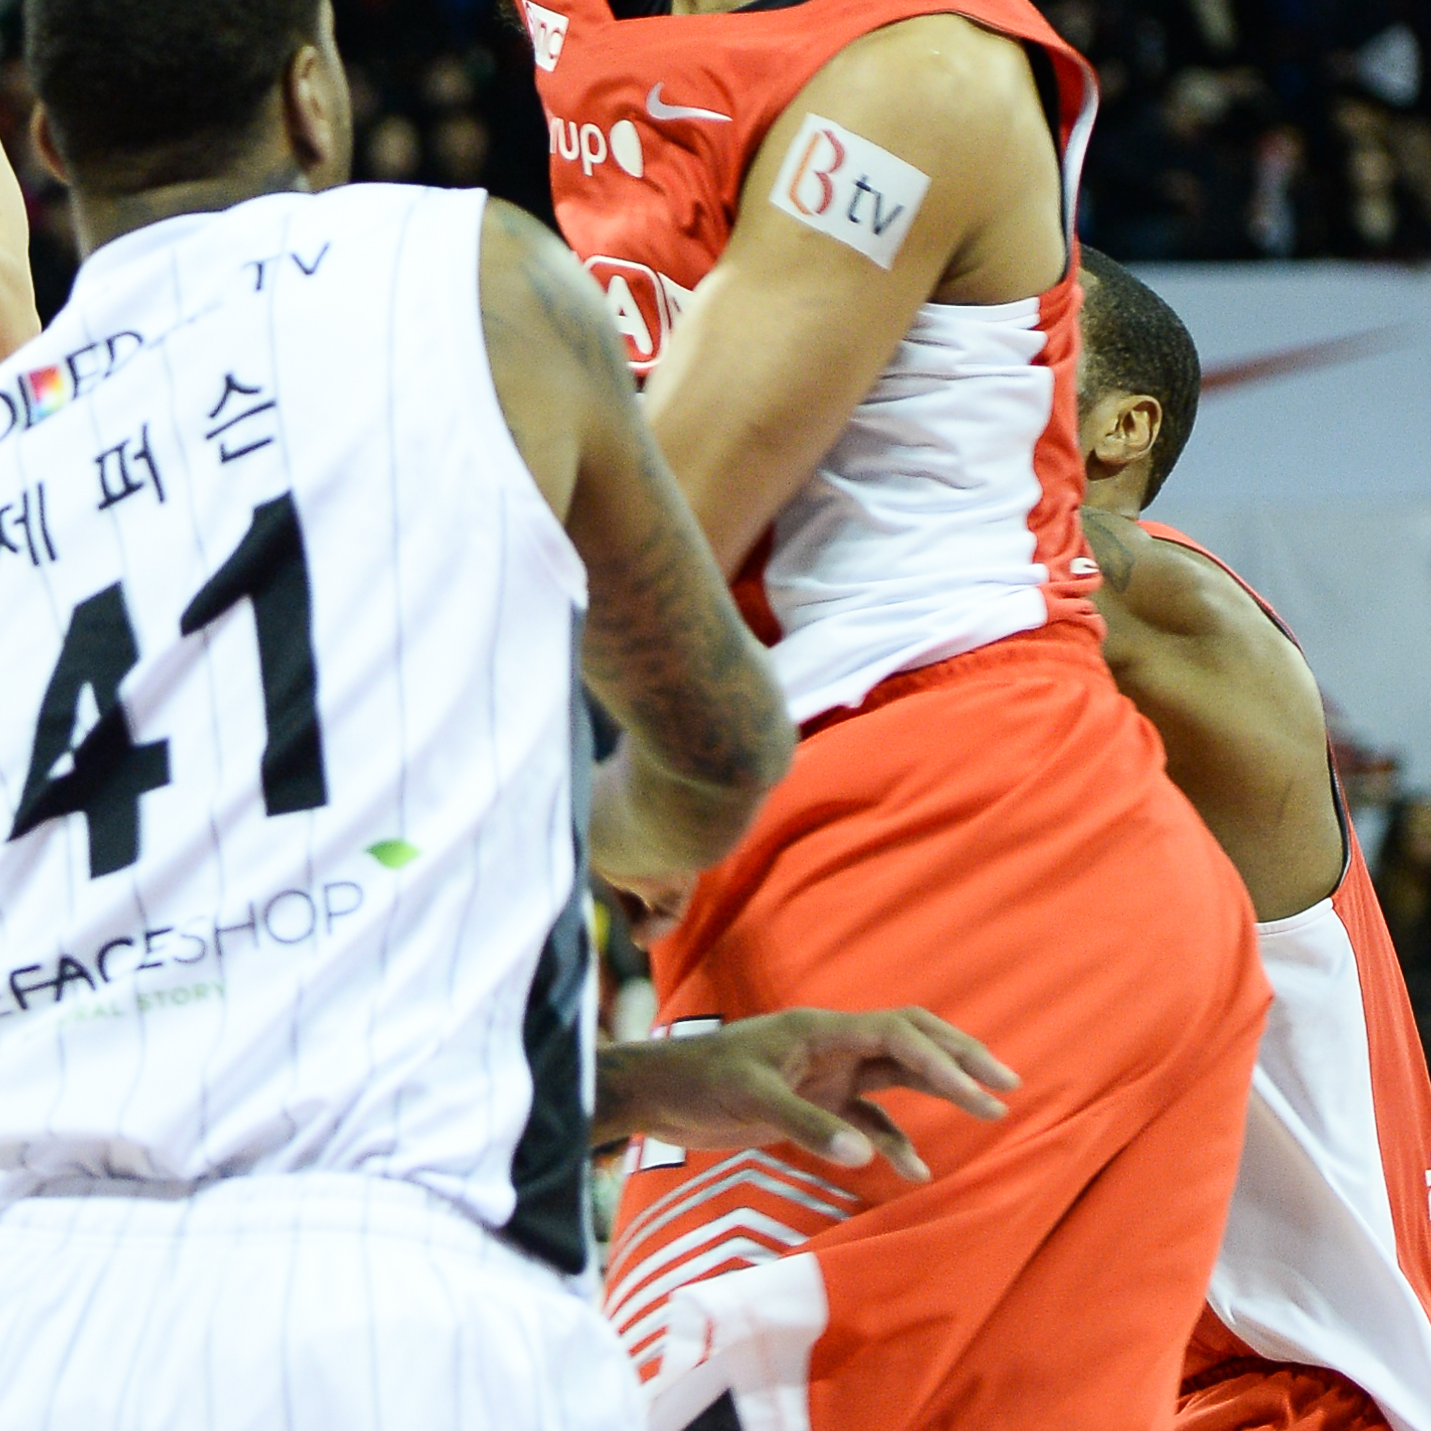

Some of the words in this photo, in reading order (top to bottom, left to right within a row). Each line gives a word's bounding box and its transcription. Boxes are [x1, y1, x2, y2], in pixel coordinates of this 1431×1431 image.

[787, 129, 845, 216] B
[847, 173, 905, 235] tv
[243, 242, 331, 292] TV
[6, 489, 330, 880] 41
